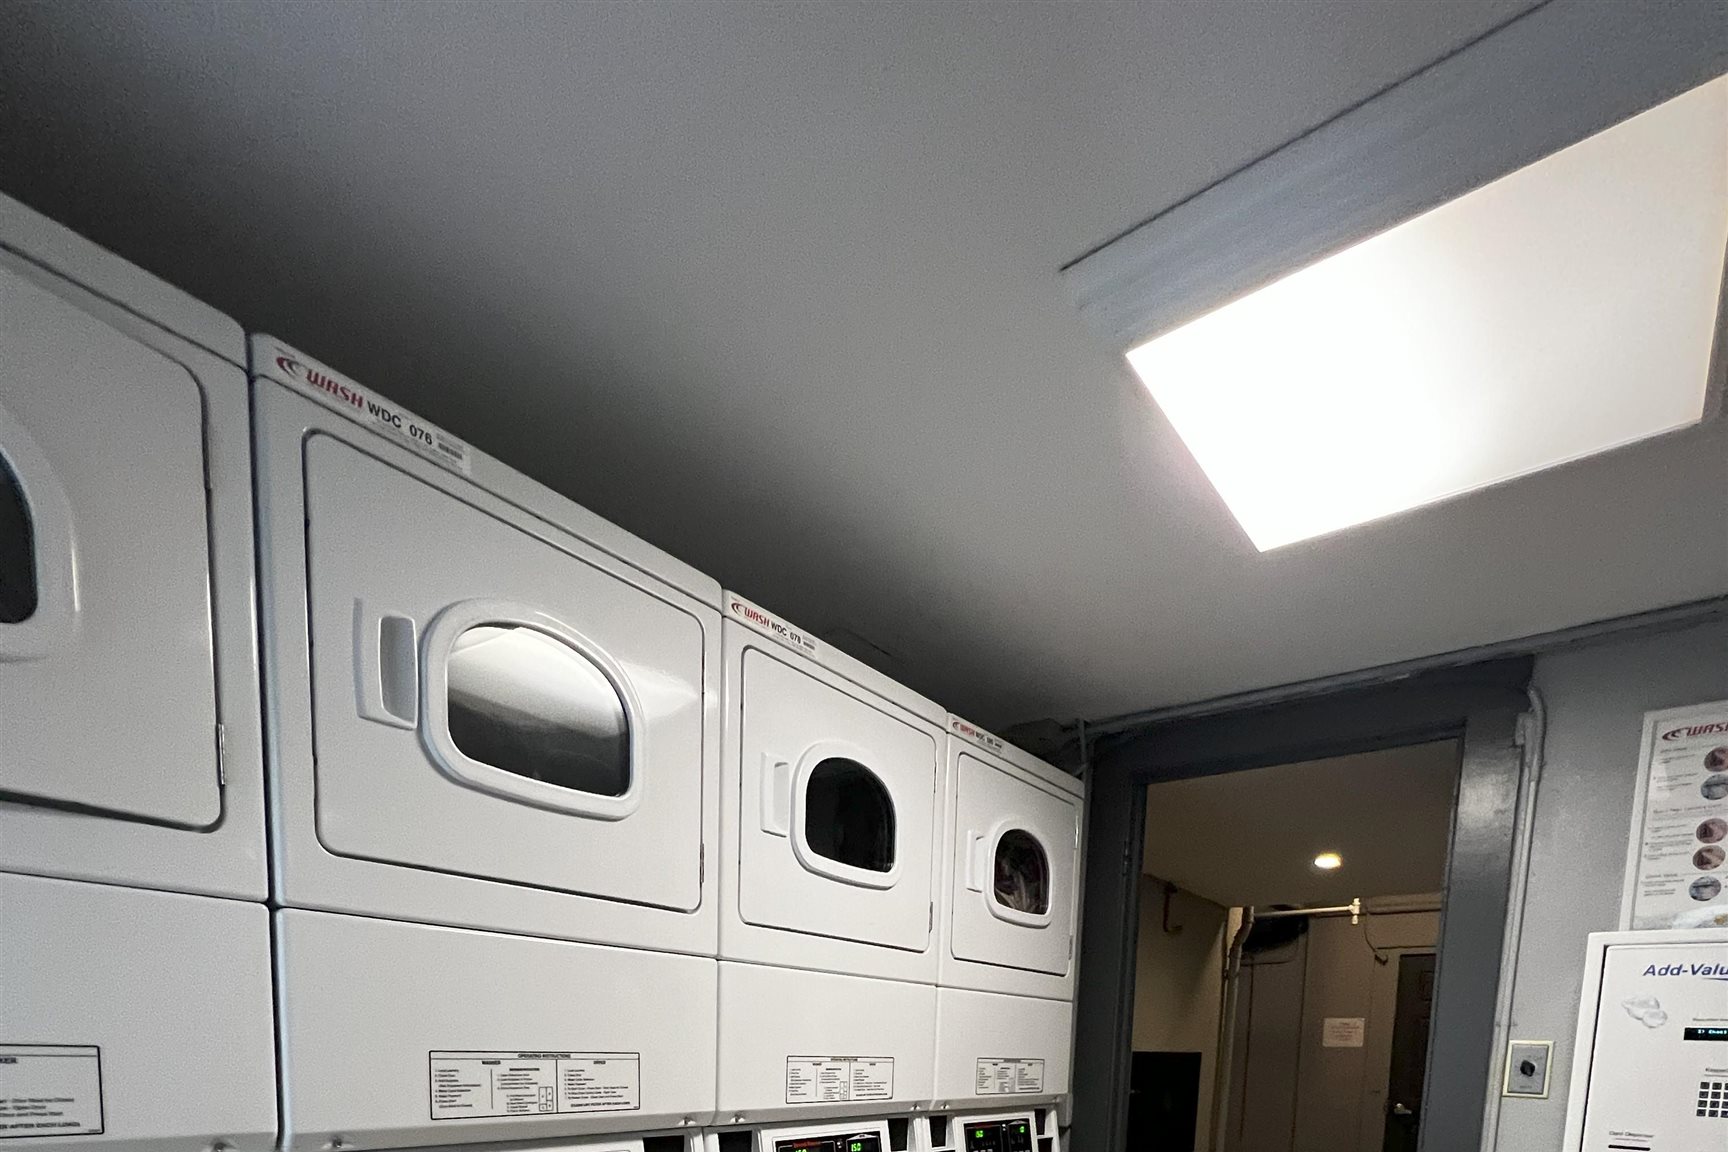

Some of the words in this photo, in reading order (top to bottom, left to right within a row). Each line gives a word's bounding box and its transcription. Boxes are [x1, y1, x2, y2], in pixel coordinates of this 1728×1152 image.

[306, 369, 364, 408] WASH
[367, 400, 402, 428] WDC
[744, 607, 770, 627] WASH
[771, 620, 787, 636] WDC
